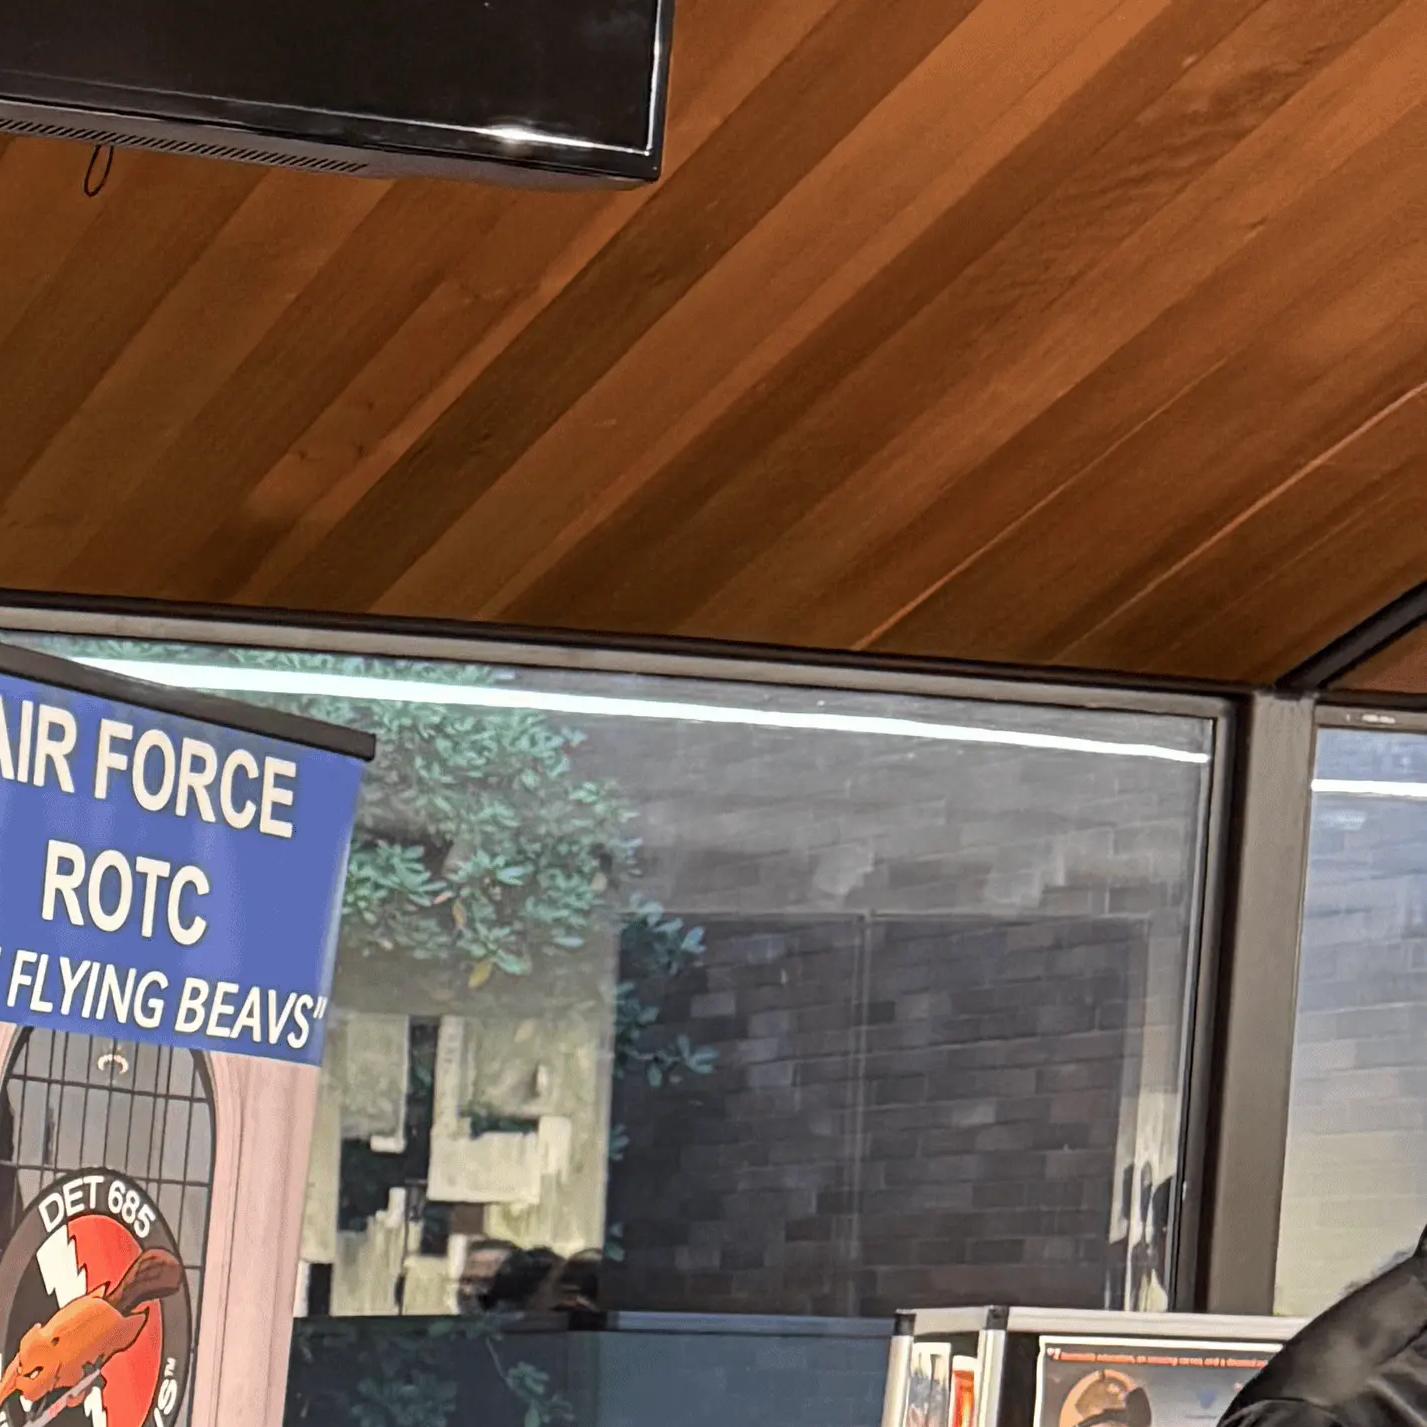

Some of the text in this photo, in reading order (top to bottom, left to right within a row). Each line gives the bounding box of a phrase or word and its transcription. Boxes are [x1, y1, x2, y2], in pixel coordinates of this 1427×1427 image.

[94, 719, 296, 838] FORCE
[41, 840, 210, 946] ROTC
[7, 949, 167, 1029] FLYING
[38, 1176, 156, 1238] DET 685
